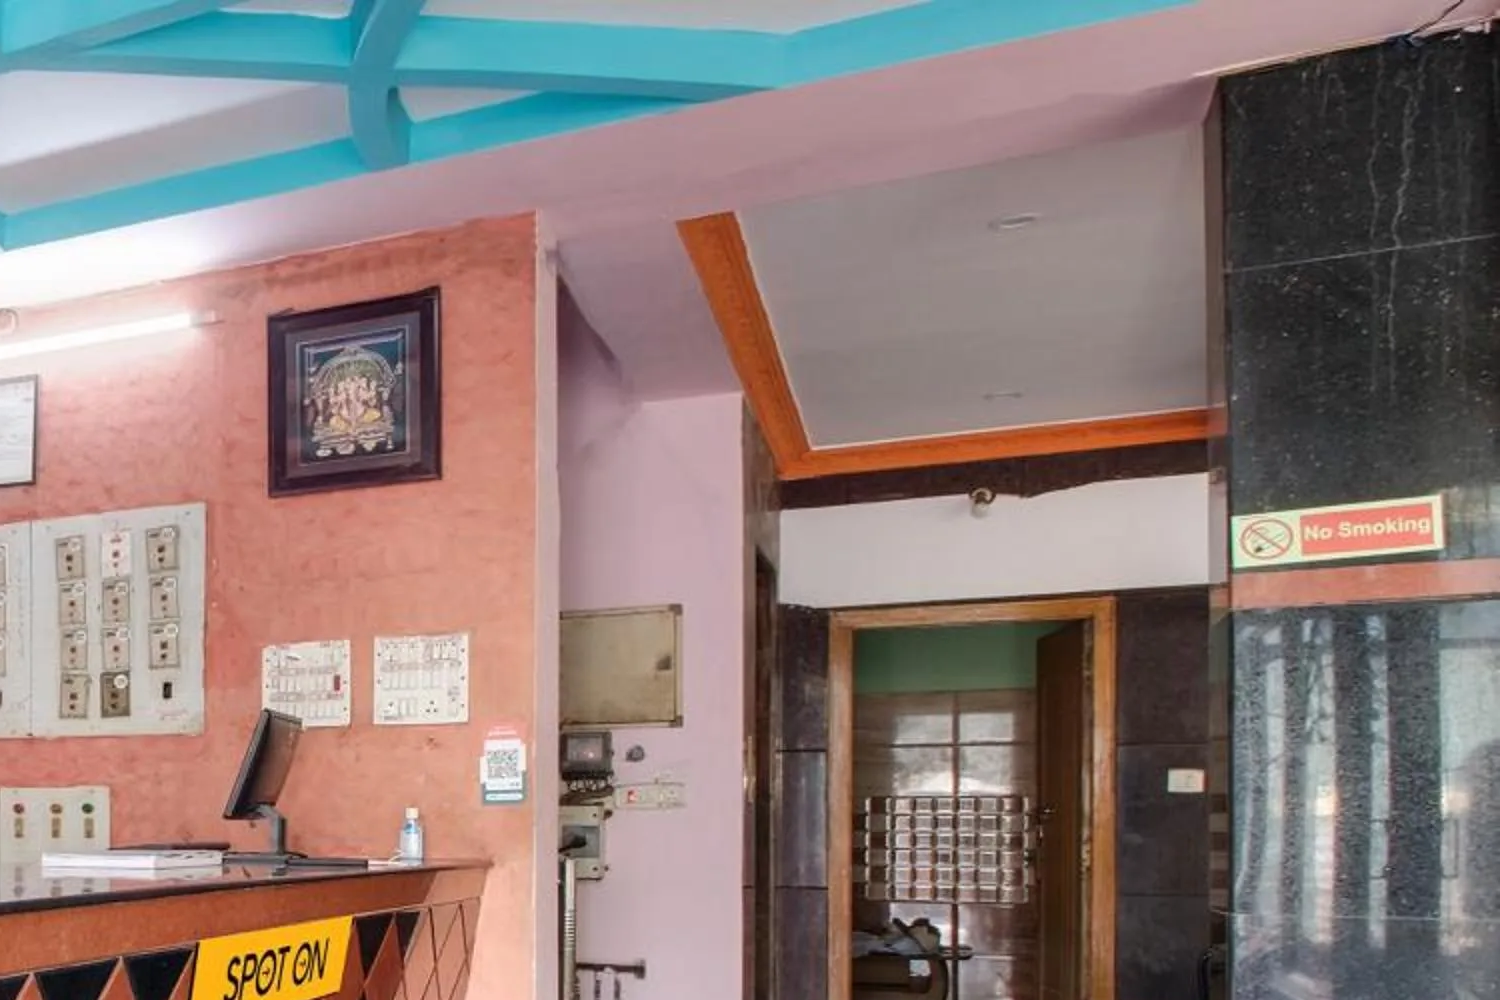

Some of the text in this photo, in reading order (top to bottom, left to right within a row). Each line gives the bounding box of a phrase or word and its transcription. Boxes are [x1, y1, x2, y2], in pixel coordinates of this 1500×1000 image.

[1303, 516, 1431, 541] No Smoking
[292, 937, 330, 986] ON
